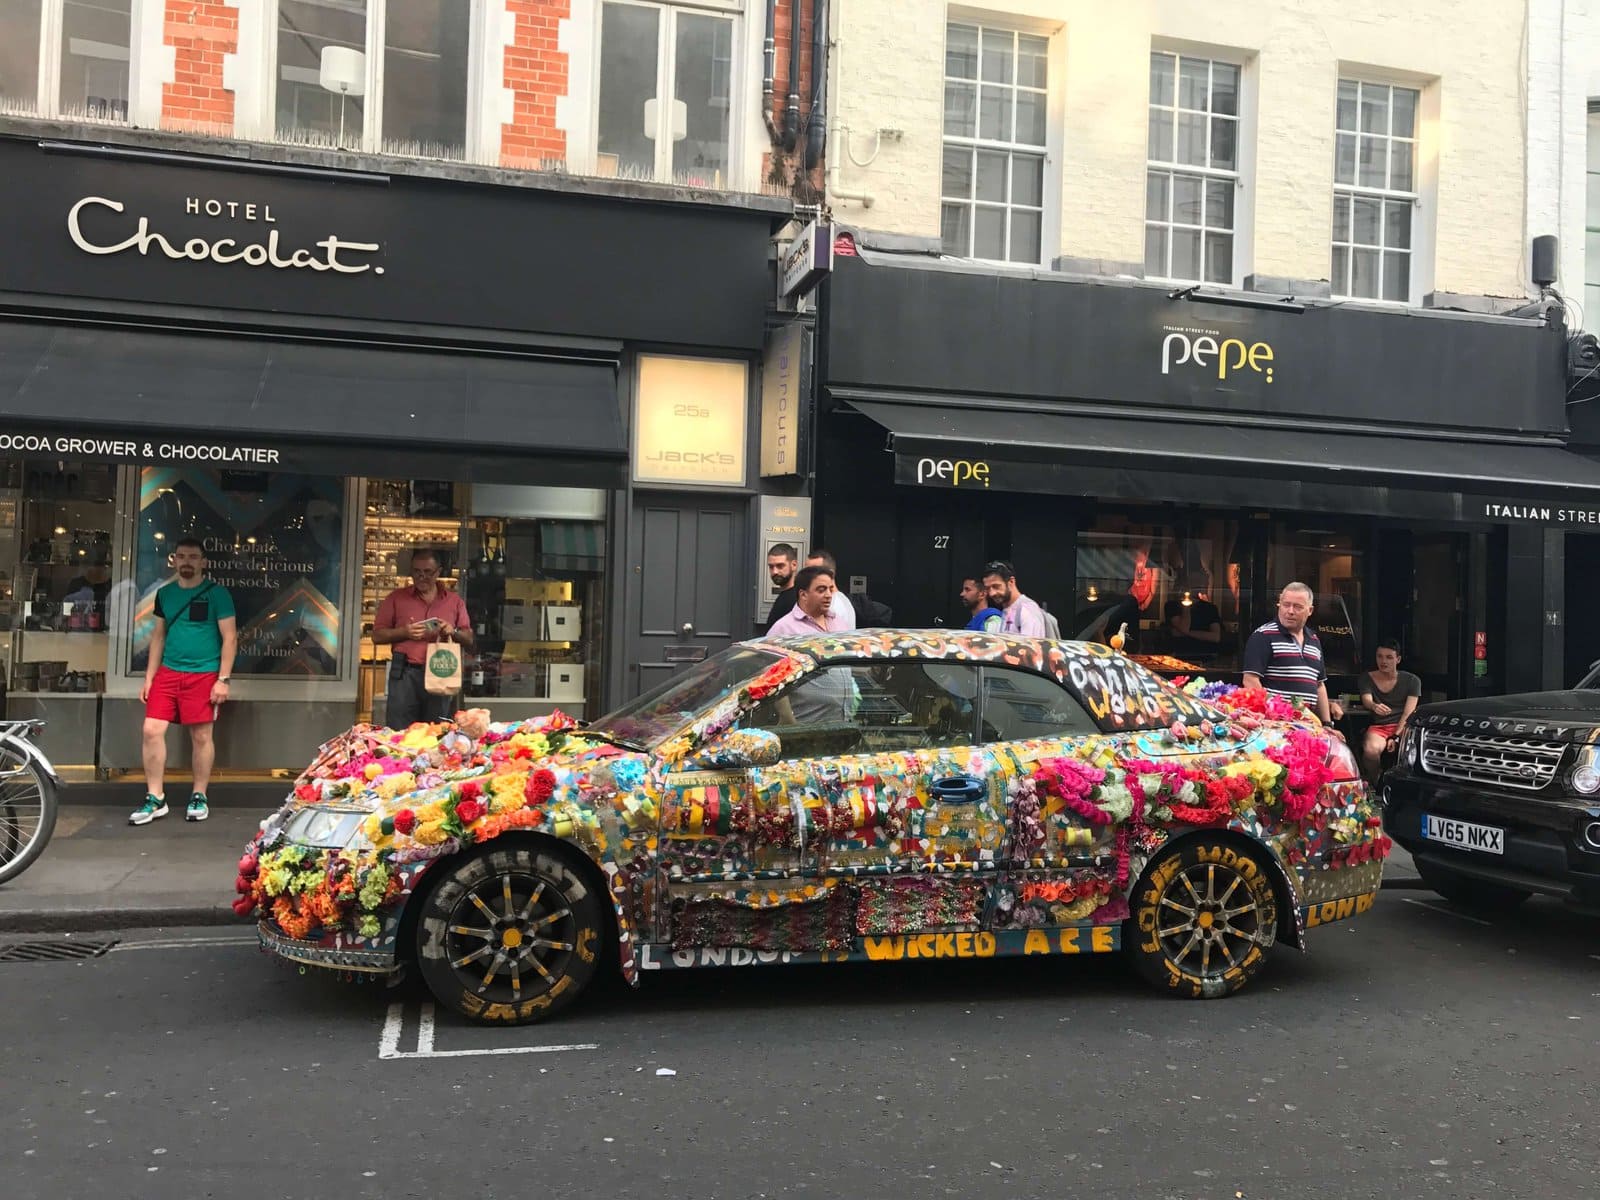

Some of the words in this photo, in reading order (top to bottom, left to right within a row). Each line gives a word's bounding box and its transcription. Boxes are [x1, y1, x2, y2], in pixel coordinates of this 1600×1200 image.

[186, 197, 276, 222] HOTEL
[67, 196, 385, 274] Chocolat.
[673, 403, 710, 418] 25a
[55, 437, 137, 457] GROWER
[142, 442, 154, 458] &
[159, 443, 279, 463] CHOCOLATIER
[1486, 504, 1550, 520] ITALIAN
[1558, 509, 1600, 523] STRE
[934, 535, 950, 549] 27
[246, 556, 314, 573] delicious
[238, 573, 280, 589] socks
[1428, 715, 1569, 737] DISCOVERY
[1428, 816, 1464, 843] LV65
[1468, 826, 1500, 850] NKX
[1024, 927, 1114, 954] ACE
